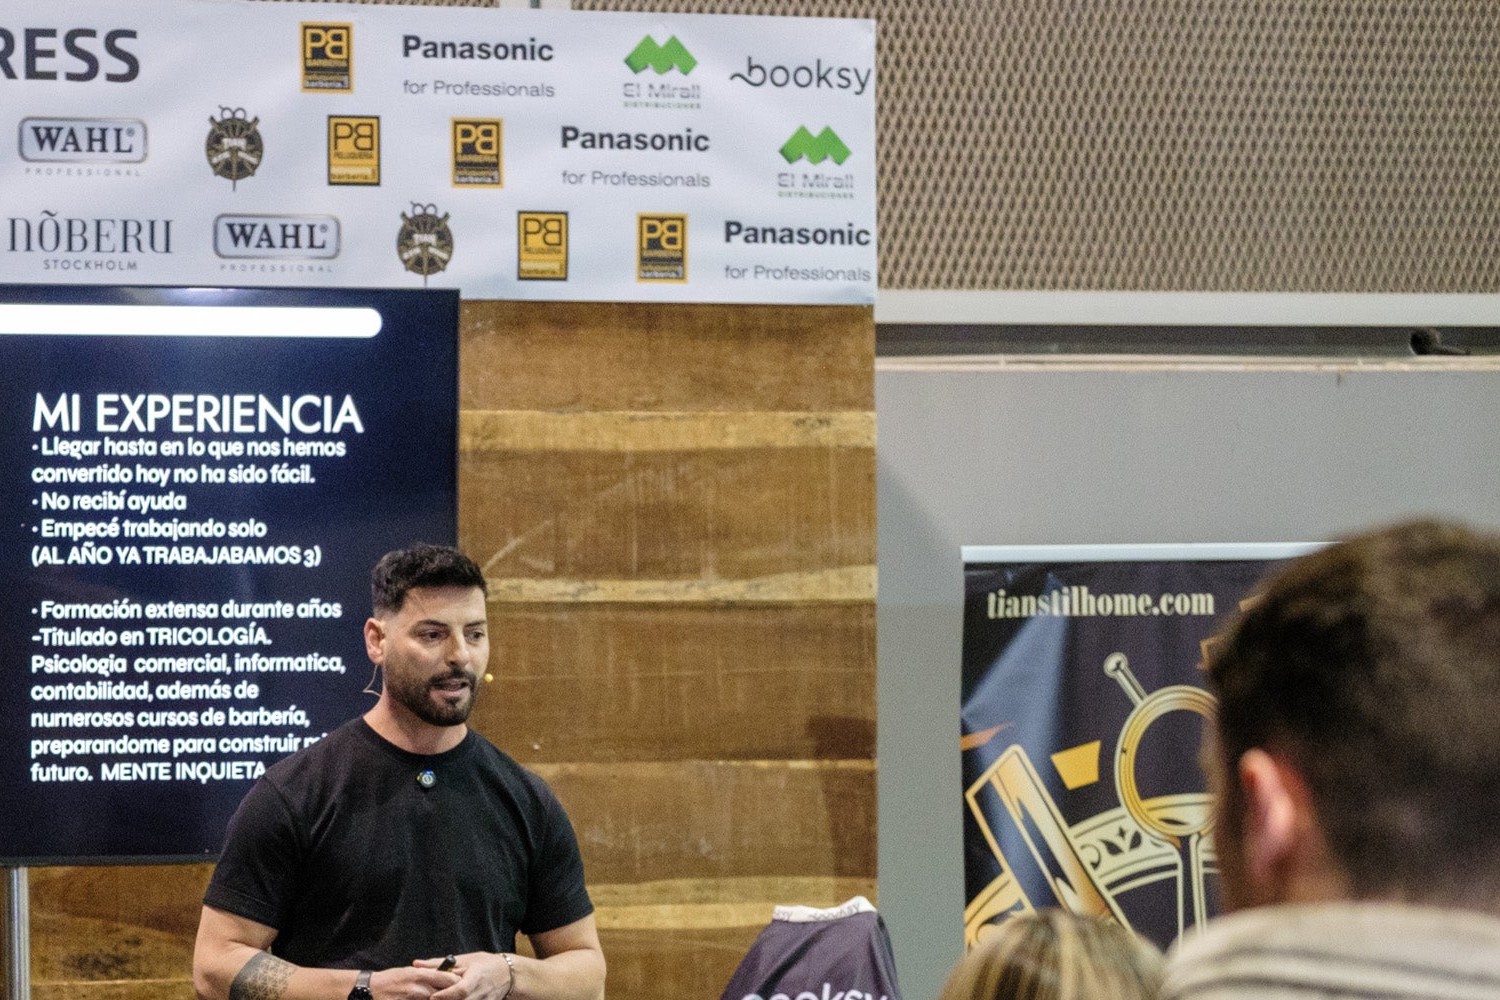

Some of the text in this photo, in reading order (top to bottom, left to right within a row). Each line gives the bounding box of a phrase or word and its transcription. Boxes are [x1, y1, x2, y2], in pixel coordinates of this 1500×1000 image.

[403, 35, 554, 61] Panasonic
[730, 57, 871, 95] booksy
[403, 79, 555, 97] for Professionals
[561, 126, 710, 152] Panasonic
[25, 167, 141, 177] PROFESSIONAL
[561, 171, 711, 188] for Professionals
[724, 221, 871, 247] Panasonic
[43, 259, 137, 270] STOCKHOLM
[219, 263, 333, 273] PROFESSIONAL
[724, 265, 871, 282] for Professionals
[32, 392, 365, 434] MI EXPERIENCIA
[41, 437, 347, 460] Llegar hasta en lo que nos hemos
[31, 463, 315, 487] convertido hoy no ha sido fácil.
[41, 489, 187, 514] No recibí ayuda
[41, 518, 268, 541] Empecé trabajando solo
[31, 541, 322, 567] (AL AÑO YA TRABAJABAMOS 3)
[41, 598, 342, 619] Formación extensa durante años
[987, 585, 1215, 619] tianstilhome.com
[120, 631, 145, 646] en
[147, 622, 273, 646] TRICOLOGÍA.
[31, 653, 346, 677] Psicologia comercial, informatica,
[31, 679, 260, 702] contabilidad, además de
[31, 705, 310, 728] numerosos cursos de barbería,
[31, 735, 170, 758] preparandome
[173, 738, 217, 757] para
[219, 733, 301, 752] construir
[31, 761, 267, 784] futuro. MENTE INQUIETA
